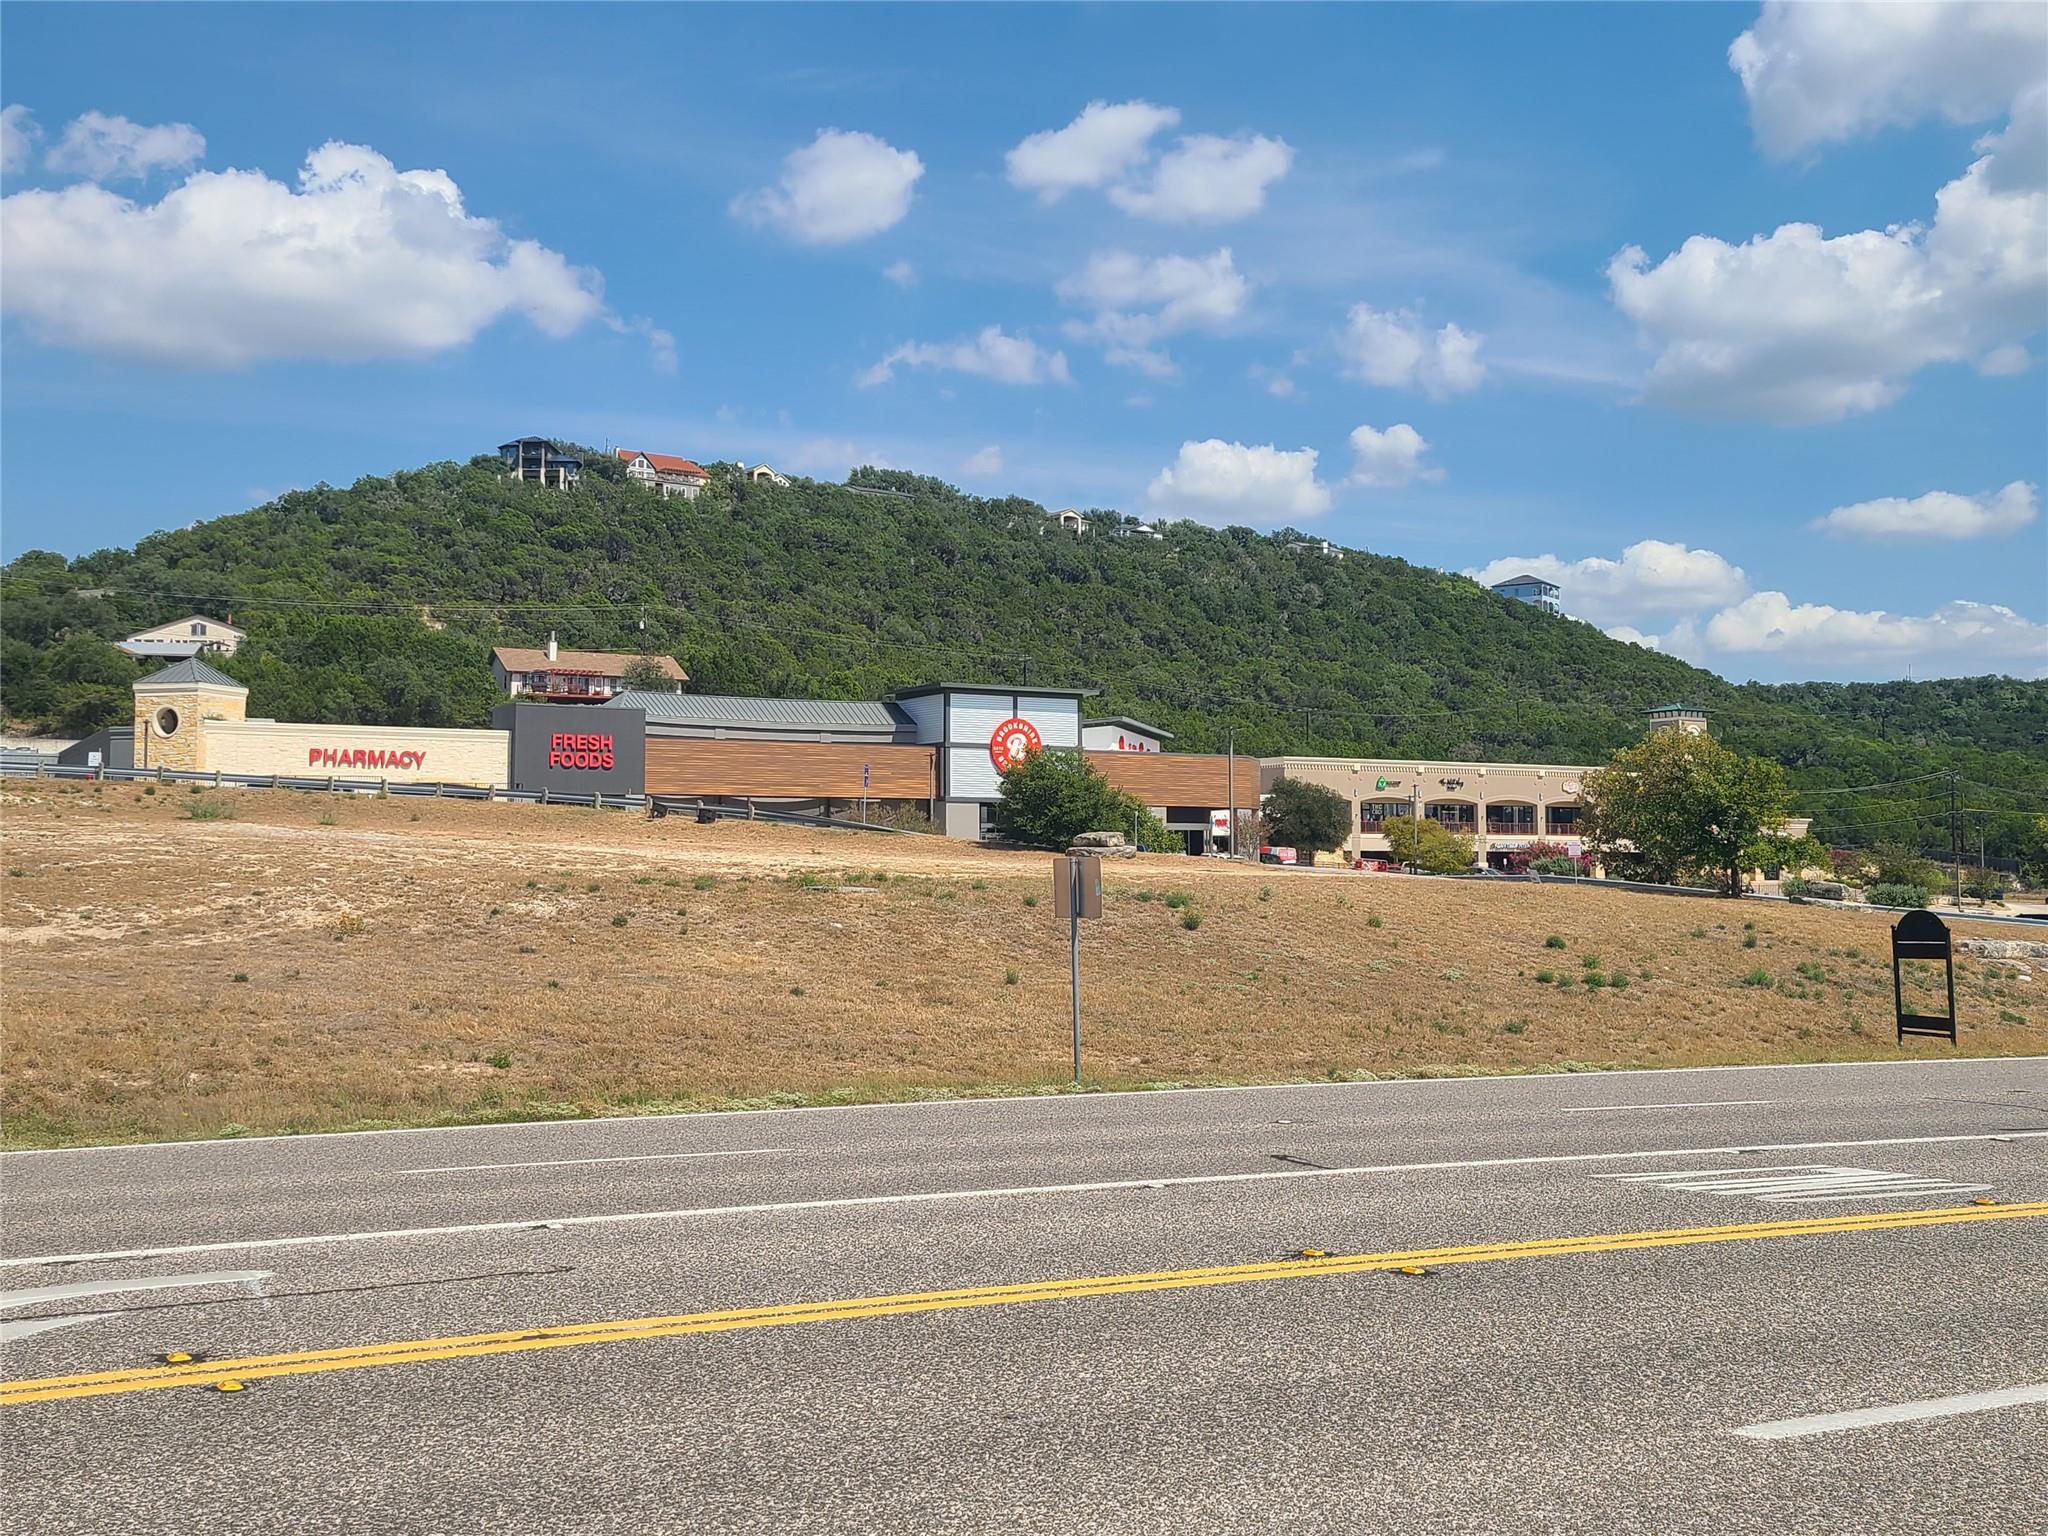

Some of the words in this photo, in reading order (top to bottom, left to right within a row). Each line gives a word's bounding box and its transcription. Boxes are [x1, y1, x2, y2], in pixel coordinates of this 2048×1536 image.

[552, 733, 613, 752] FRESH
[308, 747, 427, 771] PHARMACY
[549, 751, 614, 770] FOODS
